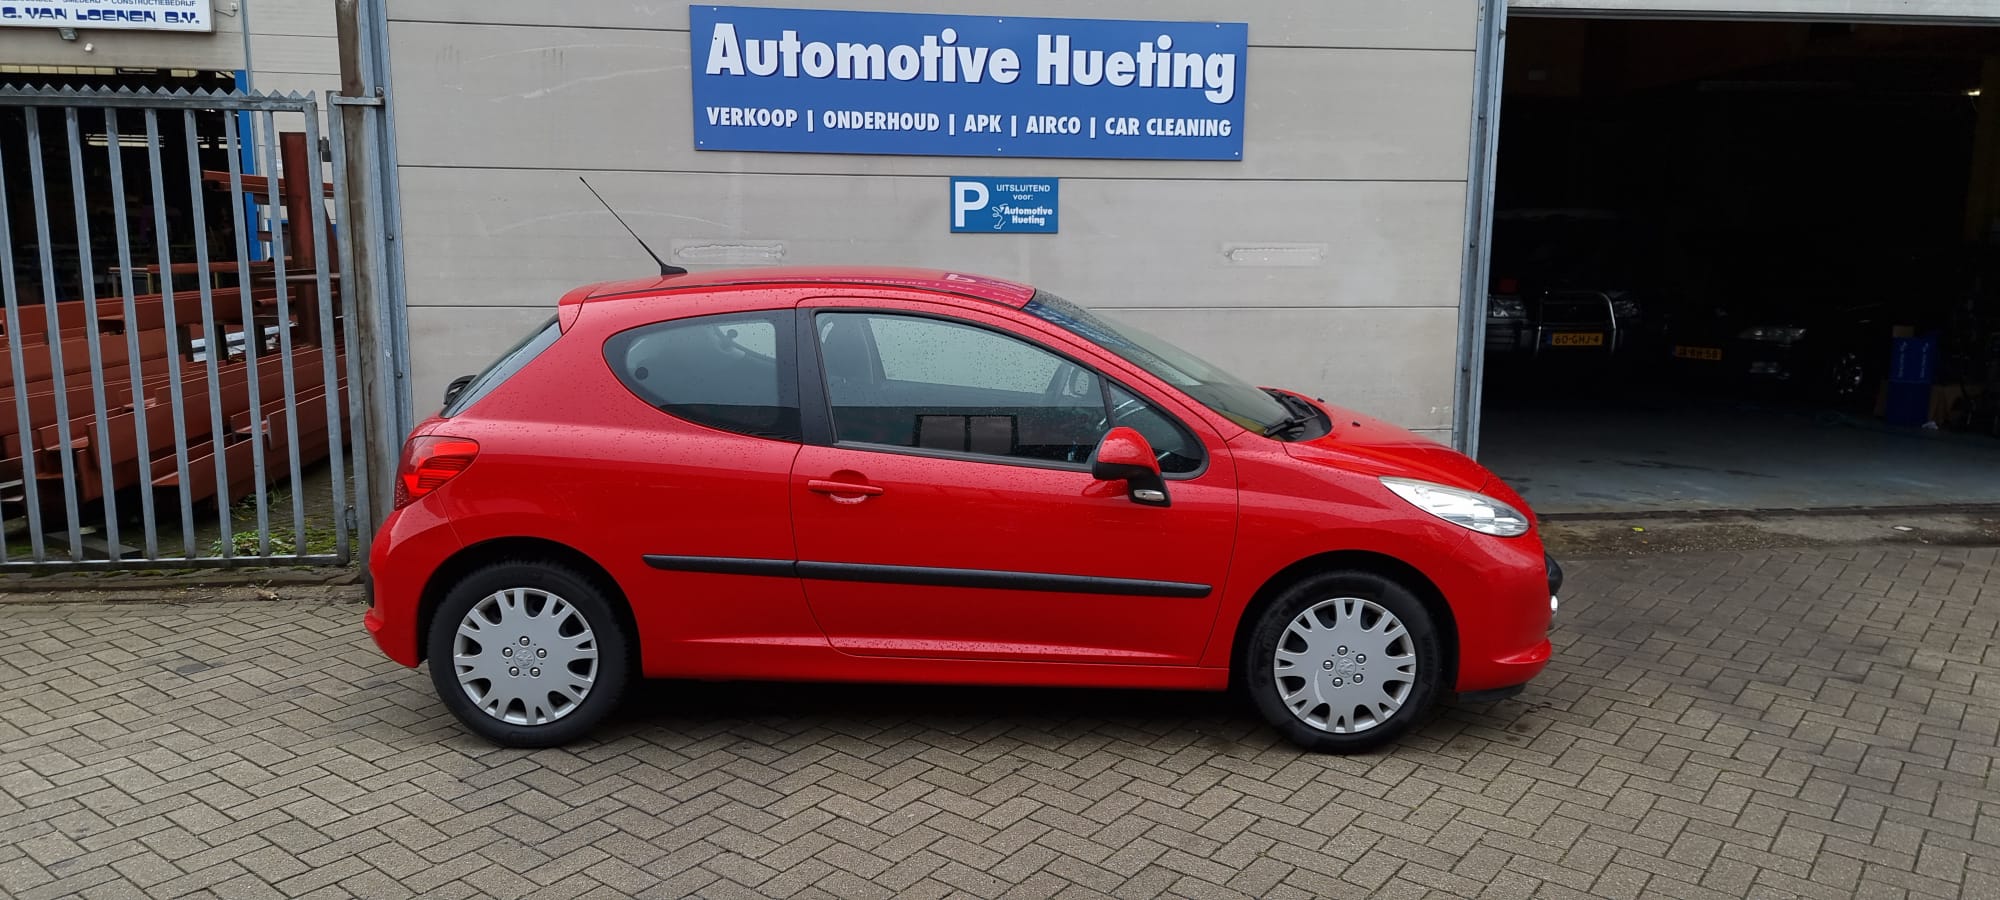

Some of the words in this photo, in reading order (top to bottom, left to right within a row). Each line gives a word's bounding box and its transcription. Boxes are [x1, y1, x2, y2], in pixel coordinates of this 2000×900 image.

[25, 8, 68, 20] VAN
[75, 9, 157, 23] LOENEN
[165, 12, 200, 24] B.V.
[706, 22, 1020, 83] Automotive
[1036, 34, 1236, 104] Hueting
[706, 106, 798, 128] VERKOOP
[823, 110, 940, 132] ONDERHOUD
[964, 114, 1002, 133] APK
[1025, 116, 1081, 135] AIRCO
[1105, 117, 1140, 136] CAR
[1146, 118, 1232, 137] CLEANING
[996, 184, 1051, 193] UITSLUITEND
[955, 181, 989, 227] P
[1004, 205, 1053, 216] Automotive
[1011, 215, 1045, 226] Hueting
